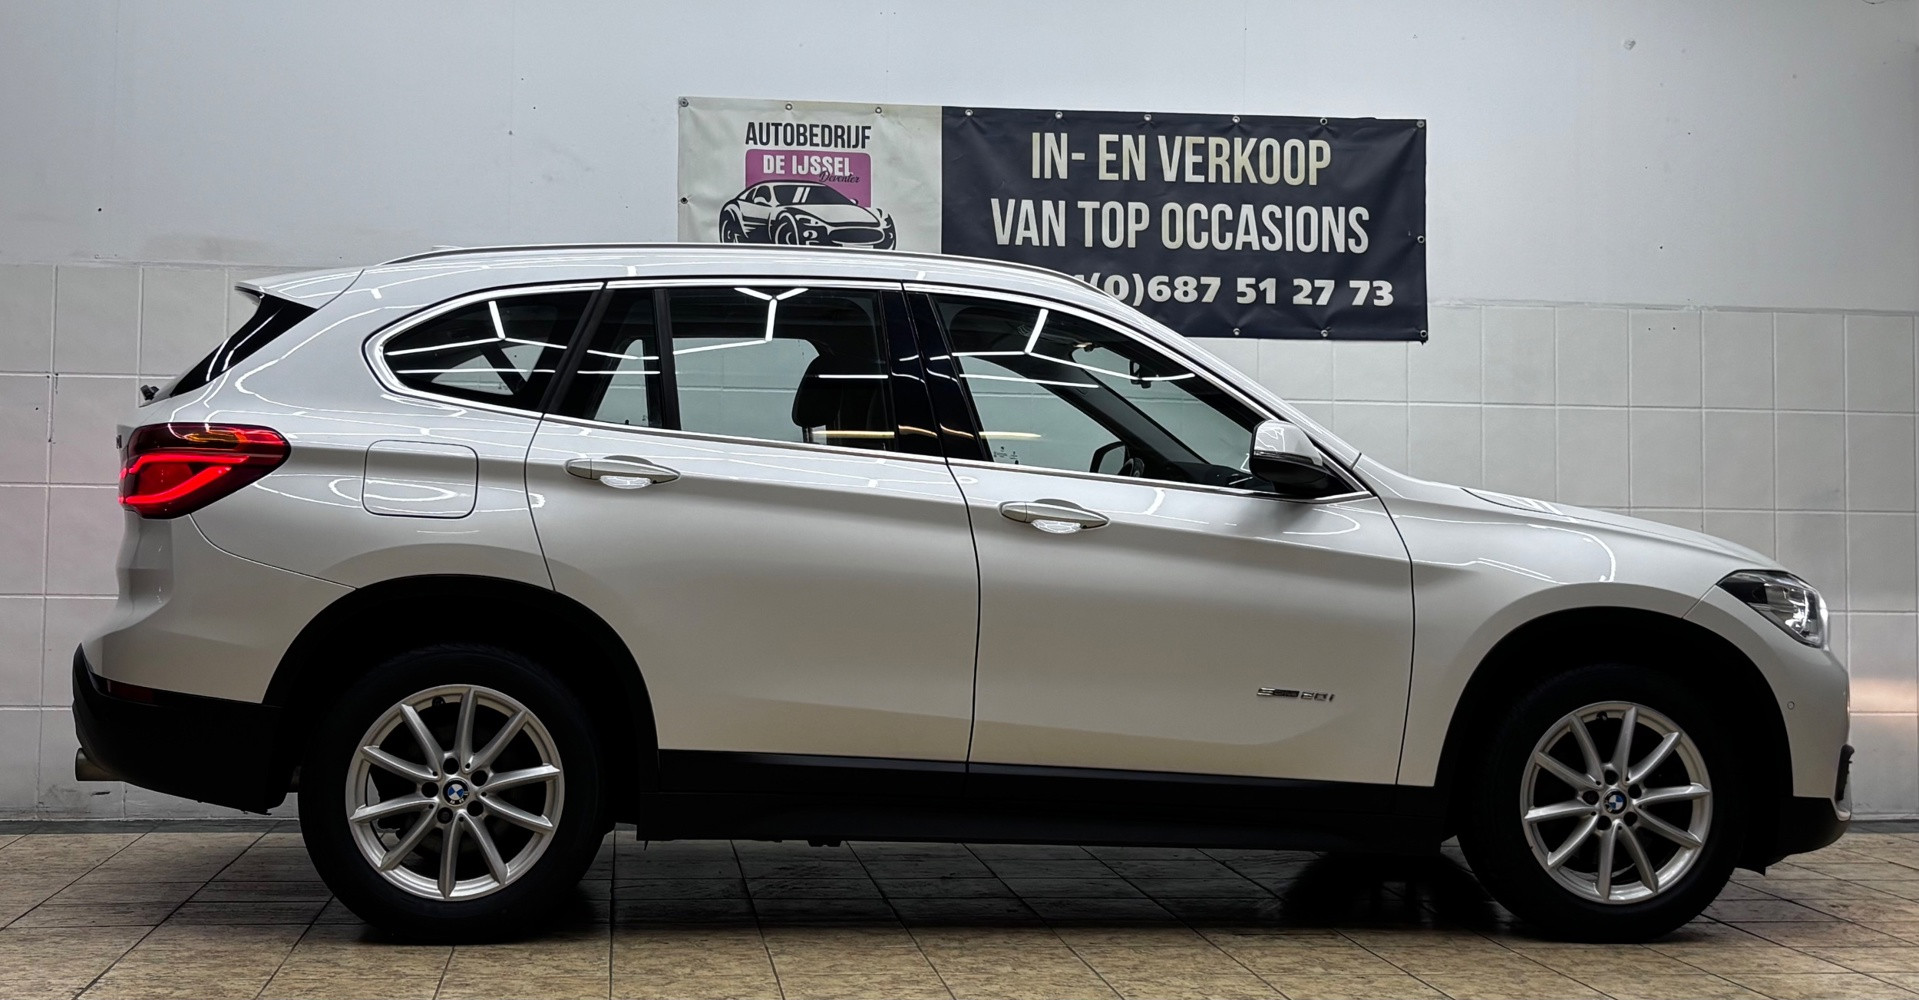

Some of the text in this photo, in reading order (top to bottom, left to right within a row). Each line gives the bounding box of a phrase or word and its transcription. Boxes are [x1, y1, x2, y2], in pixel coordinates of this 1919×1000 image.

[745, 121, 872, 149] AUTOBEDRIJF
[763, 155, 854, 176] DE IJSSEL
[1031, 132, 1331, 186] IN- EN VERKOOP
[990, 197, 1370, 254] VAN TOP OCCASIONS
[1236, 277, 1277, 304] 51
[1292, 278, 1335, 306] 27
[1349, 280, 1394, 307] 73
